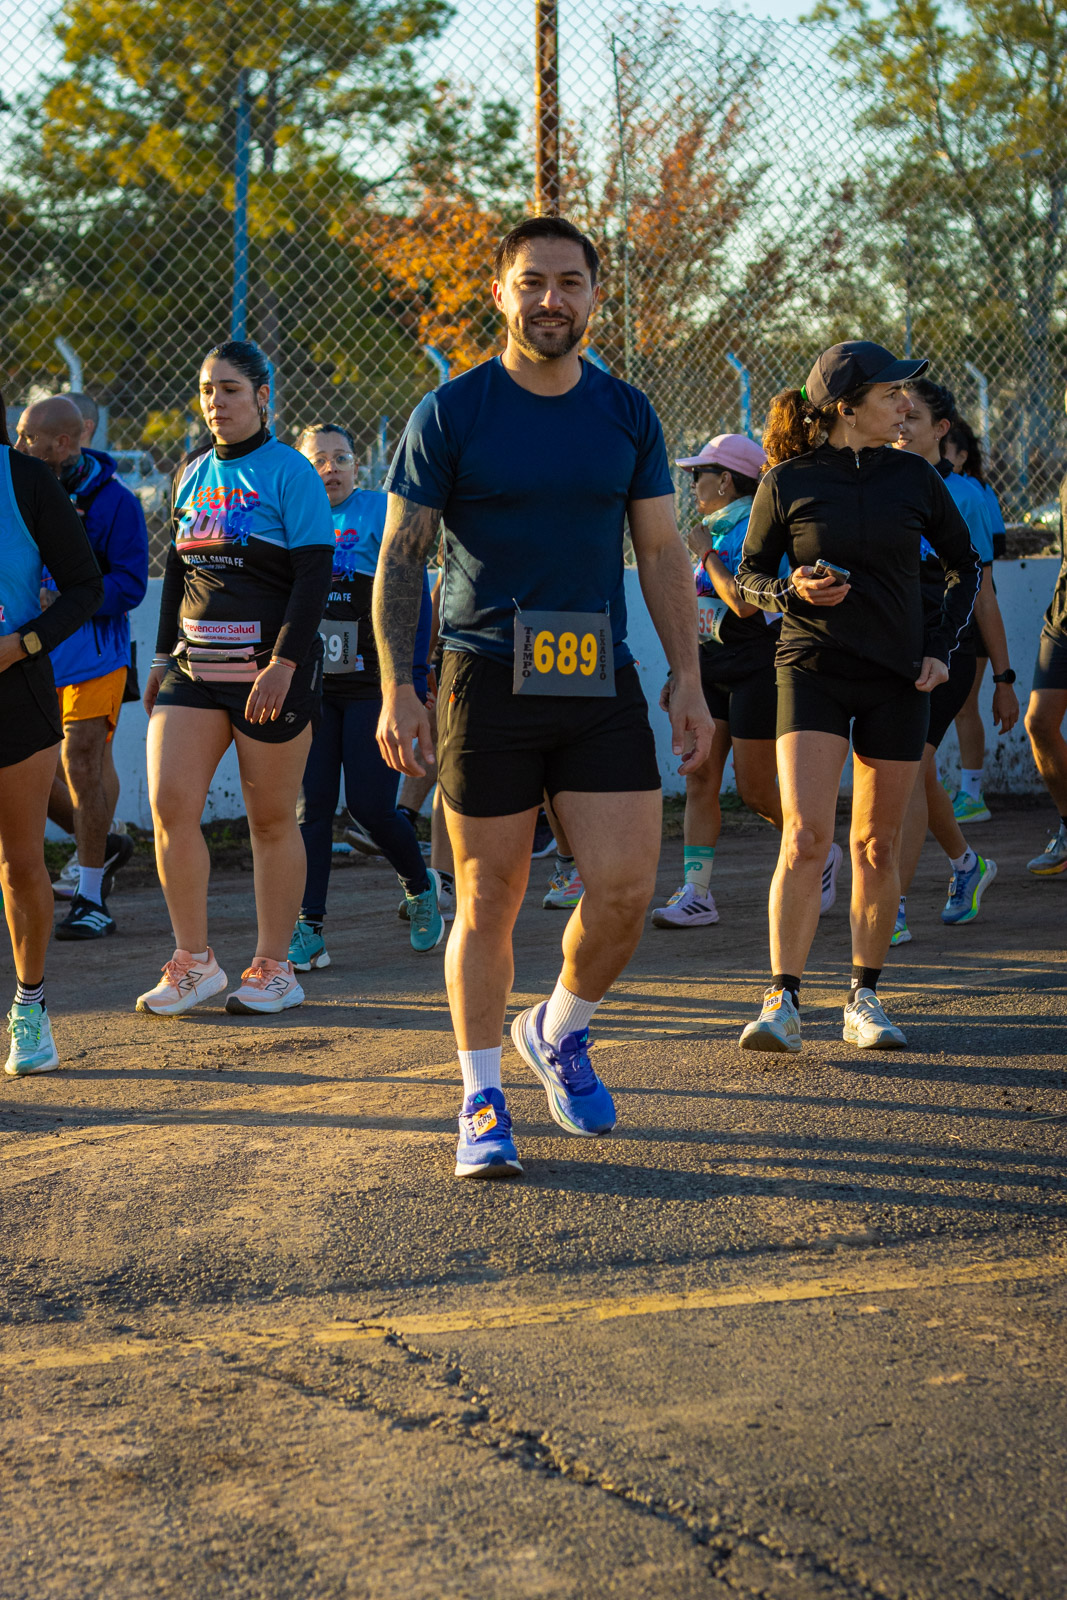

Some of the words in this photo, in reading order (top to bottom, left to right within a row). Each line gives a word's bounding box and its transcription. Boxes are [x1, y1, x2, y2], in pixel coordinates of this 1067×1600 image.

[209, 555, 234, 566] SANTA
[234, 557, 244, 568] FE
[328, 592, 342, 601] NTA
[343, 593, 351, 602] FE
[227, 624, 255, 634] Salud
[522, 626, 533, 678] TIEMPO
[533, 630, 597, 676] 689
[599, 629, 607, 680] EXACTO
